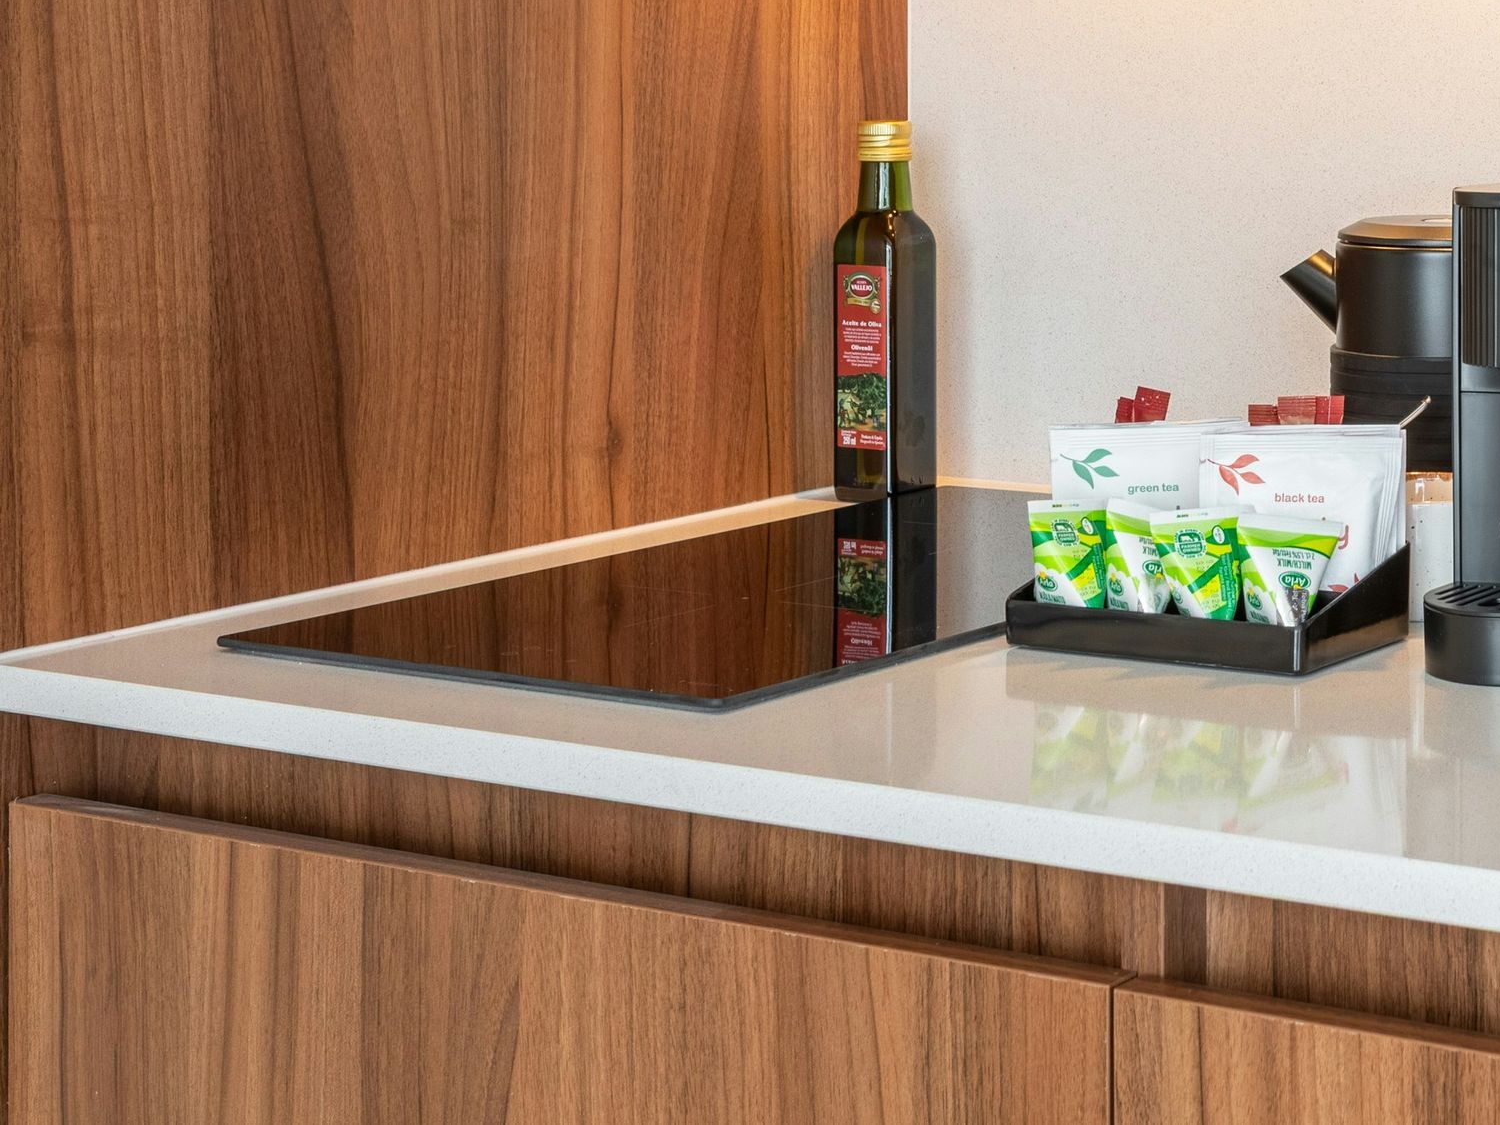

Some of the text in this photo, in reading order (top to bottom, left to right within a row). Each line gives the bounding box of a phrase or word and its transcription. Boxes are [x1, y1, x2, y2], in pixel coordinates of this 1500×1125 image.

[1128, 483, 1180, 495] green tea
[1274, 493, 1325, 503] black tea
[1148, 564, 1162, 574] rla
[1285, 575, 1306, 584] Arla
